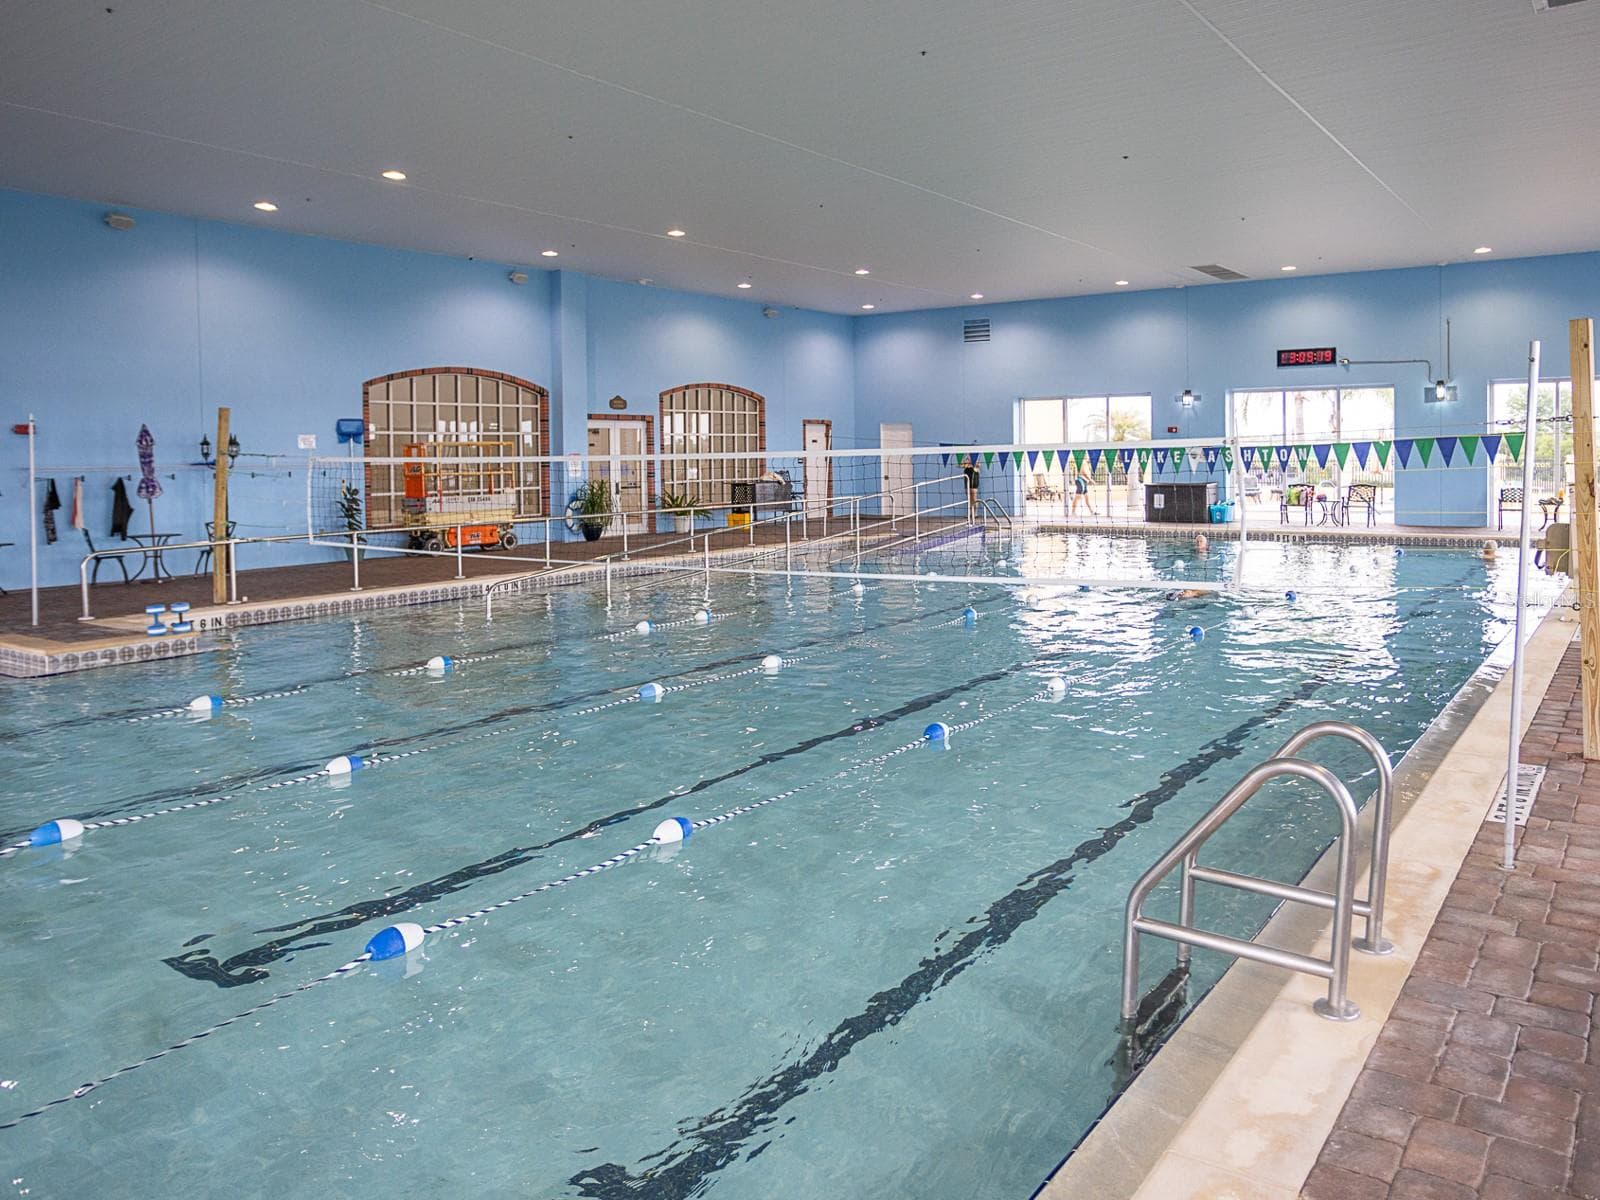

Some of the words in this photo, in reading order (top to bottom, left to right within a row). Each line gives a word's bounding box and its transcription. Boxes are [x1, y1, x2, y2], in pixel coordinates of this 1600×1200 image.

[1124, 449, 1181, 463] LAKE
[1208, 448, 1307, 463] ASHTON
[200, 619, 206, 629] 6
